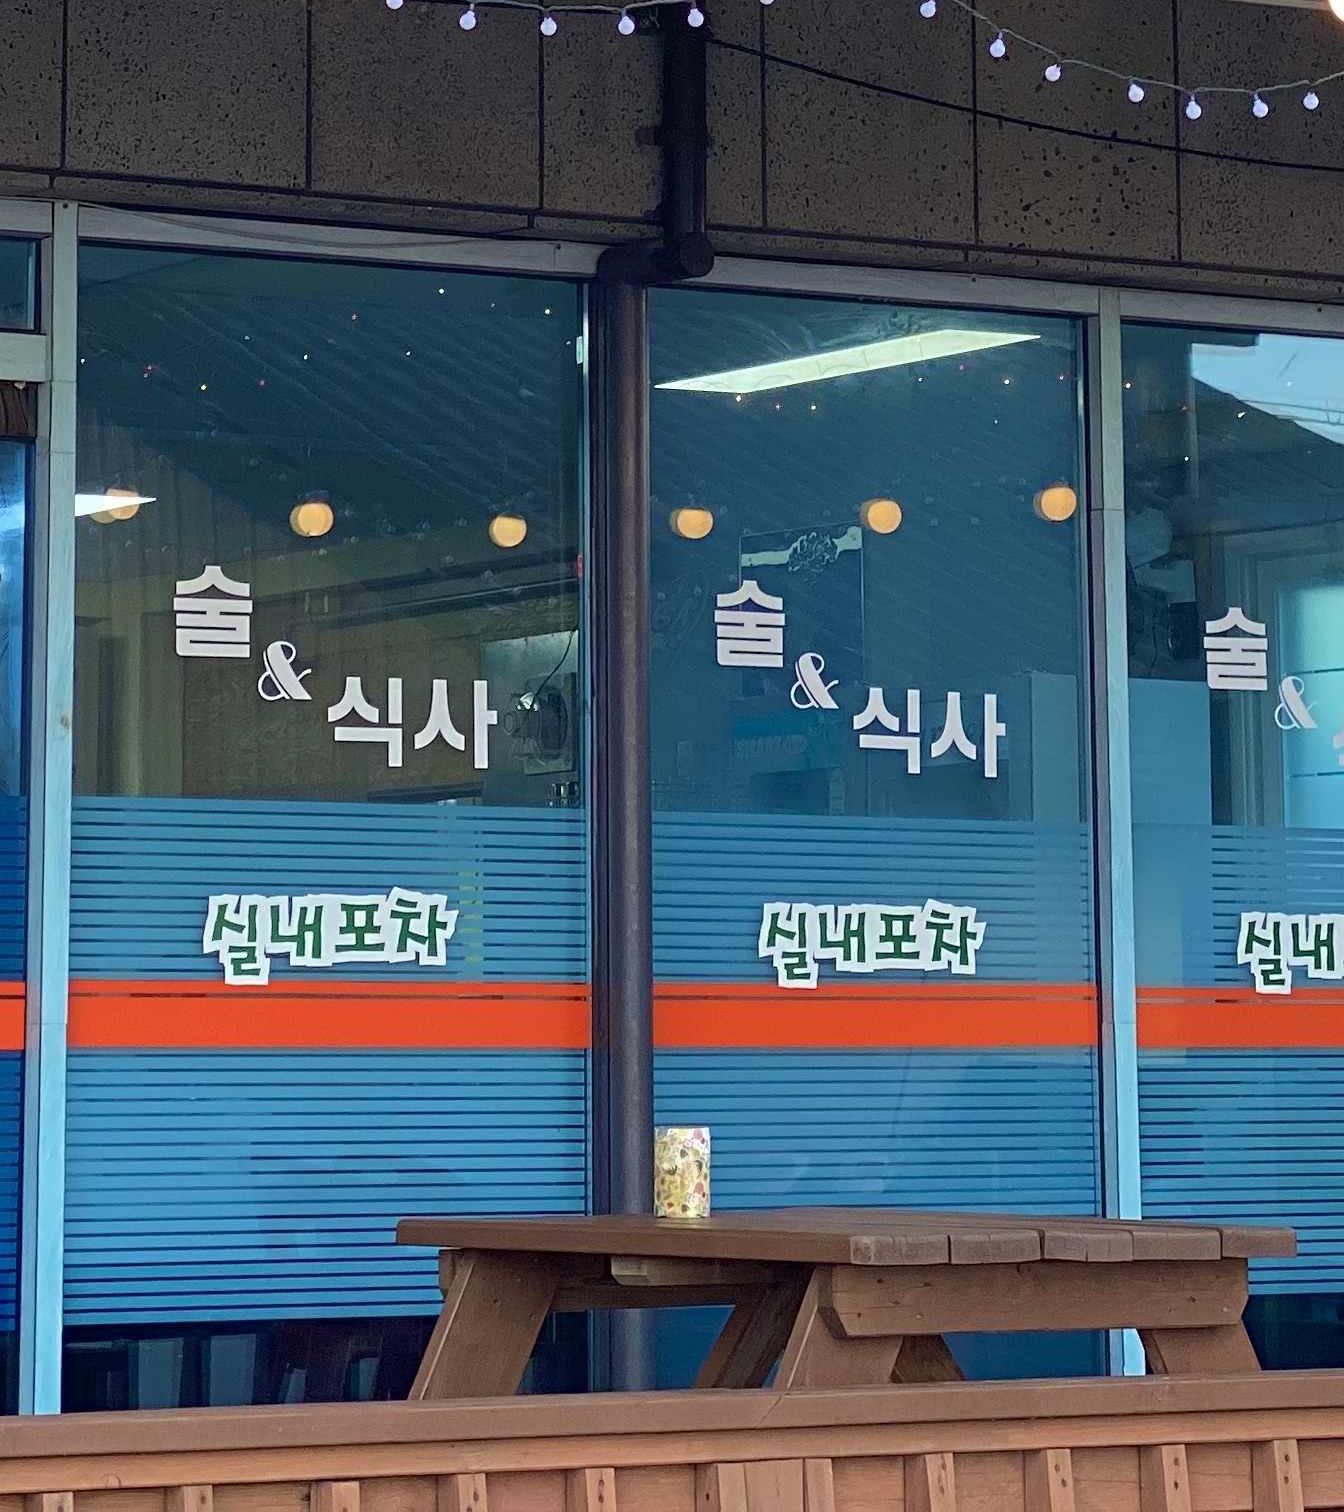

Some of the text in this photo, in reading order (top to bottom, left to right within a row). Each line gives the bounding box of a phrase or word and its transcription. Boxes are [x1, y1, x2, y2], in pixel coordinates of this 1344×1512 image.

[173, 565, 498, 769] 술 & 식사
[714, 580, 1006, 778] 술 & 식사
[1203, 607, 1269, 691] 술
[1274, 676, 1319, 729] &
[210, 895, 453, 977] 실내포차
[765, 907, 980, 981] 실내포차
